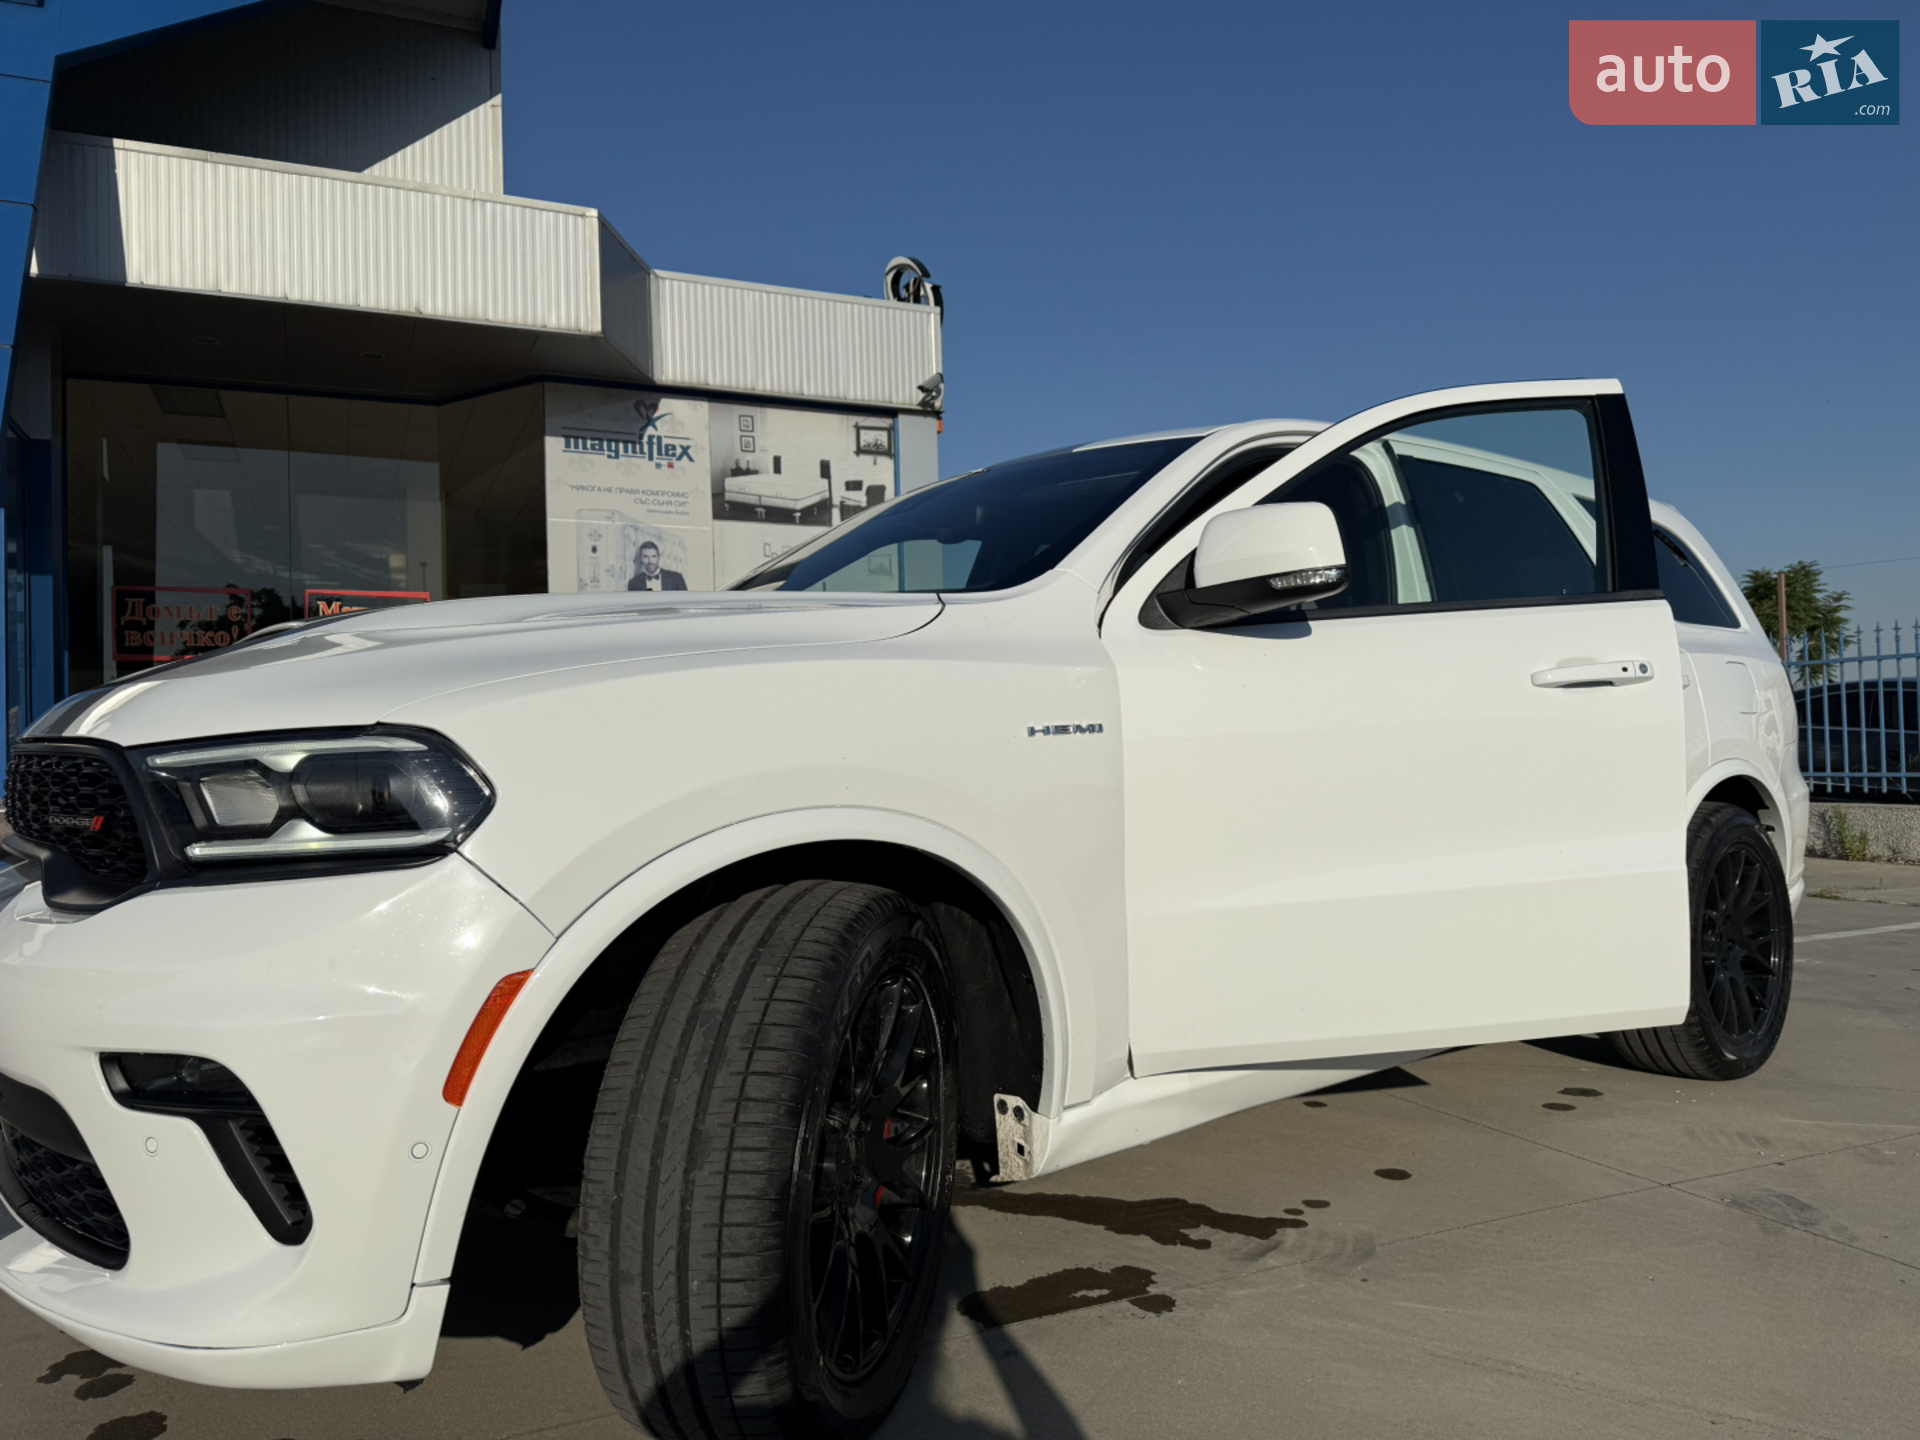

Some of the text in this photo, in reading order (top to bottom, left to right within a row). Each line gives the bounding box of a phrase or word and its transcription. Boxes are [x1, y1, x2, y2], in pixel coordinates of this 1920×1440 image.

[562, 434, 695, 462] magniflex
[604, 486, 614, 494] НЕ
[615, 487, 640, 495] ПРАВЯ
[641, 489, 689, 499] КОМПРОМИС
[634, 497, 651, 505] СЪС
[120, 598, 243, 626] Домът е
[124, 623, 240, 648] всичко!
[1026, 723, 1104, 738] HEMI
